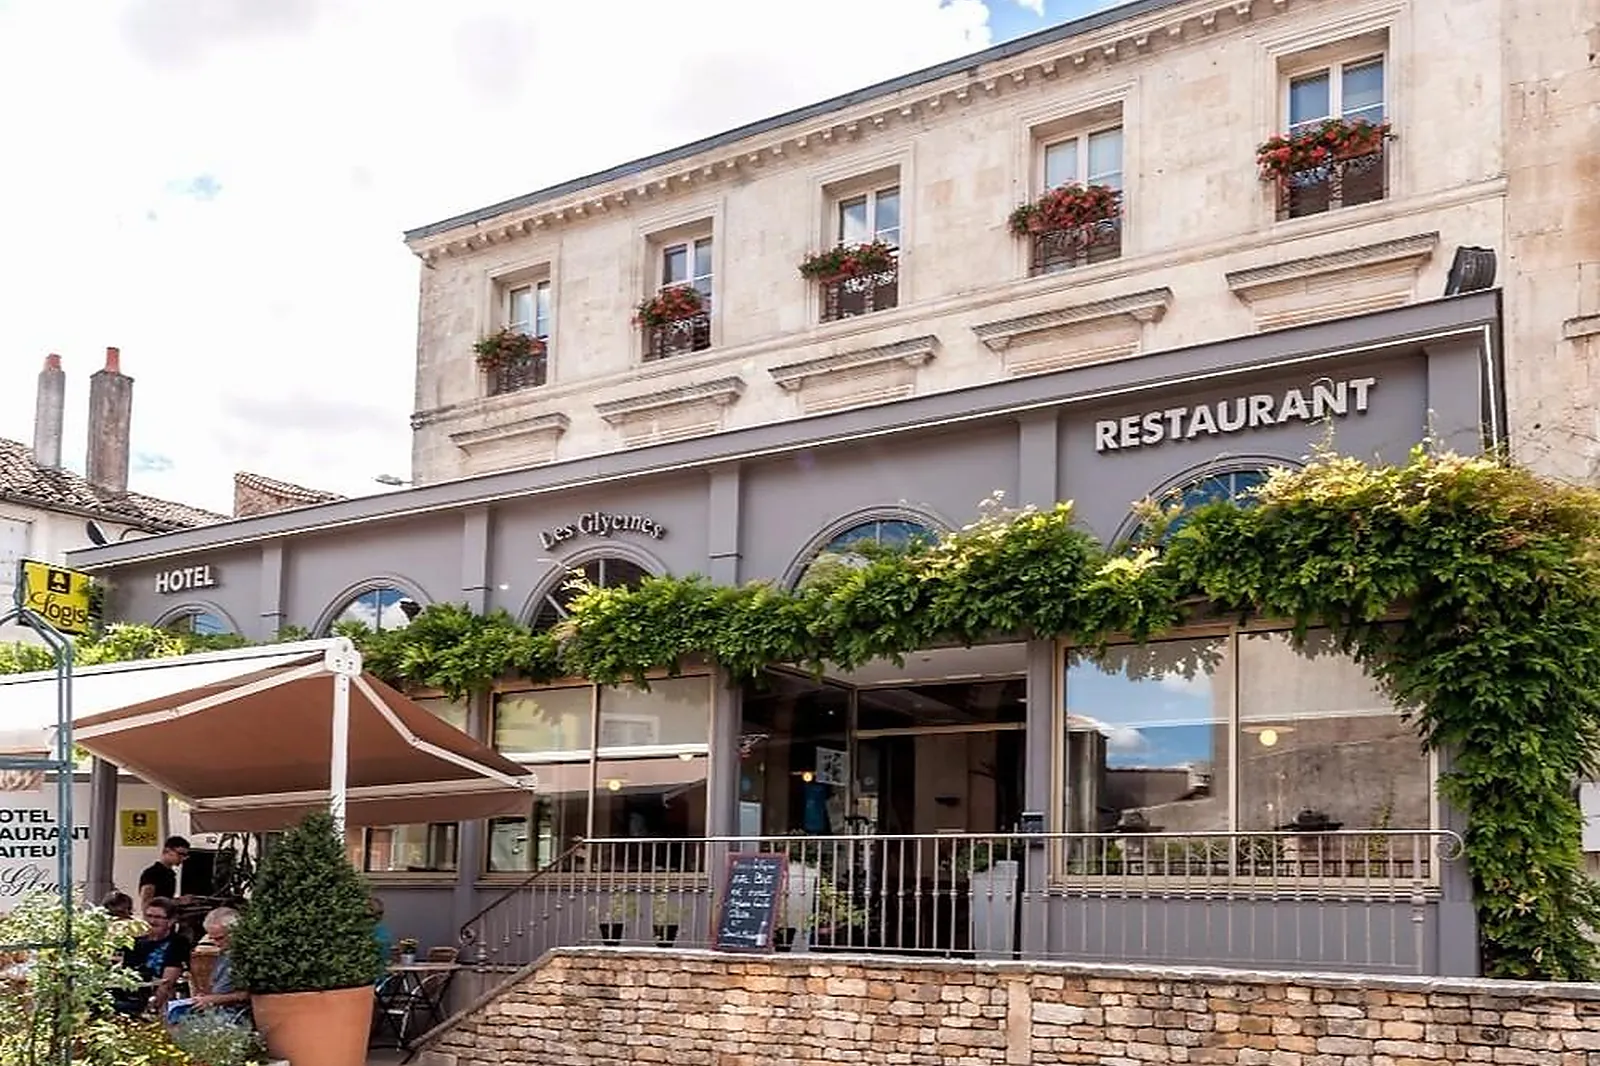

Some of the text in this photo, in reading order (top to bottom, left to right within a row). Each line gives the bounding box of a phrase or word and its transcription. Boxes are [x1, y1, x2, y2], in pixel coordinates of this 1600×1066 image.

[1095, 377, 1375, 450] RESTAURANT
[538, 511, 665, 550] Les Glycines
[154, 565, 215, 593] HOTEL
[0, 845, 57, 858] AITEU
